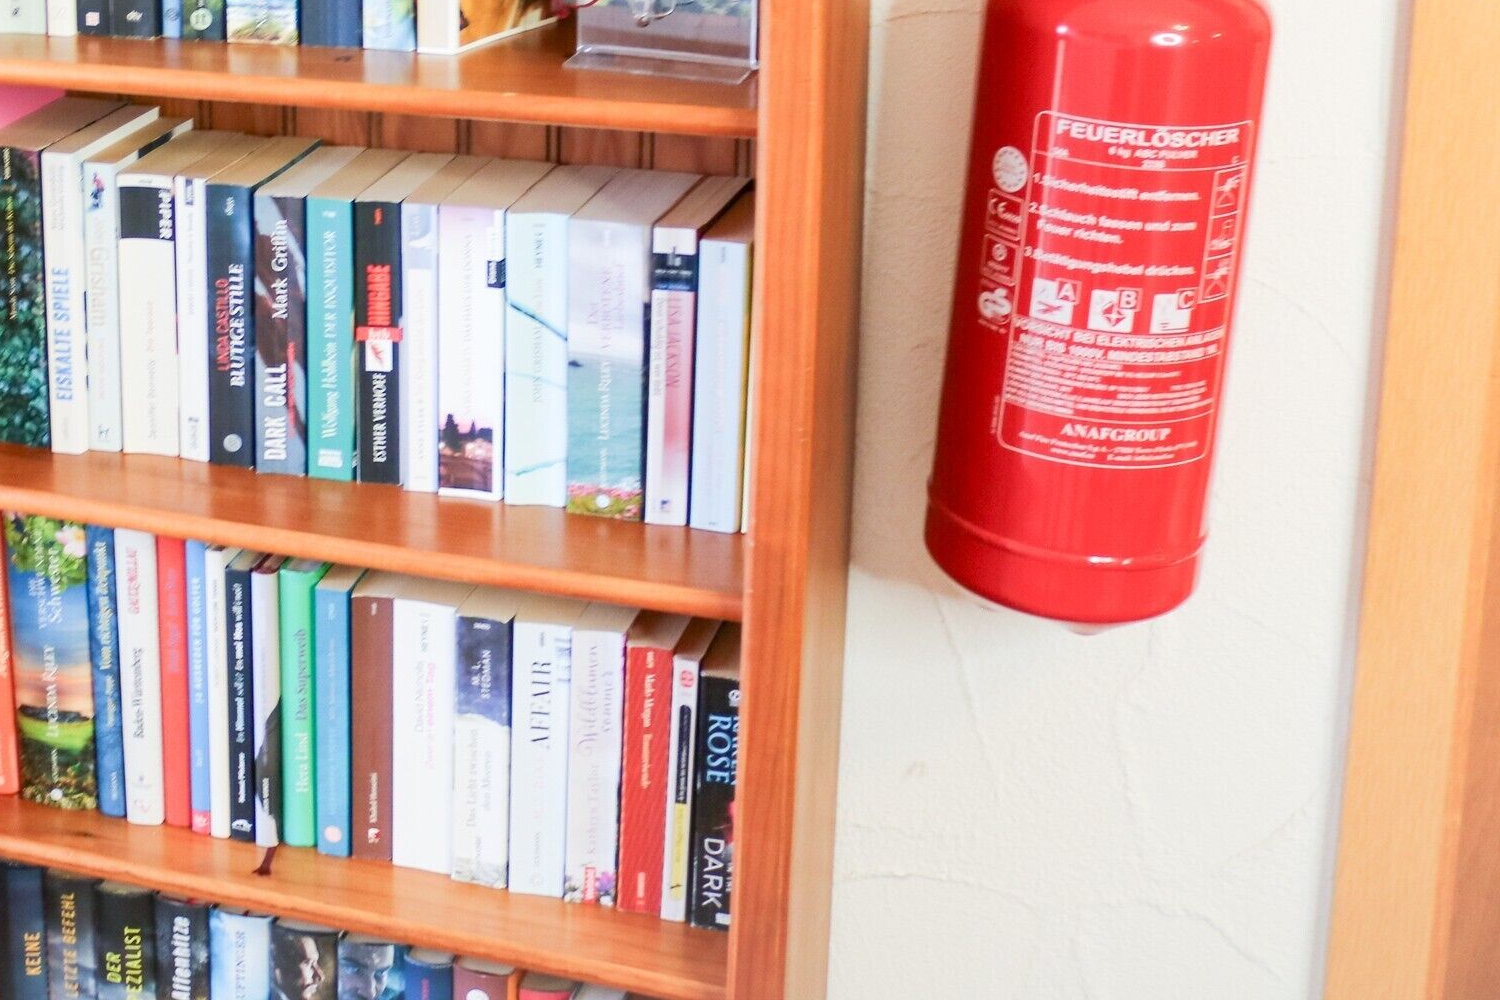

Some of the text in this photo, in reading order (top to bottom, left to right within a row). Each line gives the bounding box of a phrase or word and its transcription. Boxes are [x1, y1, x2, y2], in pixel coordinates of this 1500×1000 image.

[1056, 119, 1241, 148] FEUERLÖSCHER
[269, 218, 289, 320] Mark Griffin
[1058, 282, 1077, 302] A
[214, 278, 231, 372] LINDA CASTILLO
[228, 263, 246, 387] BLUTIGE STILLE
[1120, 290, 1138, 310] B
[1178, 290, 1197, 310] C
[50, 266, 74, 402] EISKALTE SPIELE
[262, 362, 287, 461] DARK CALL
[321, 391, 339, 440] Wolfgang
[372, 422, 387, 463] ESTHER
[292, 628, 311, 721] Das Superweib
[481, 649, 492, 699] STEDMAN
[528, 660, 554, 750] AFFAIR
[294, 731, 309, 761] Lind
[705, 713, 732, 785] ROSE
[702, 837, 726, 908] DARK
[60, 893, 78, 945] BEFEHL
[23, 931, 43, 977] KEINE
[105, 951, 123, 984] DER
